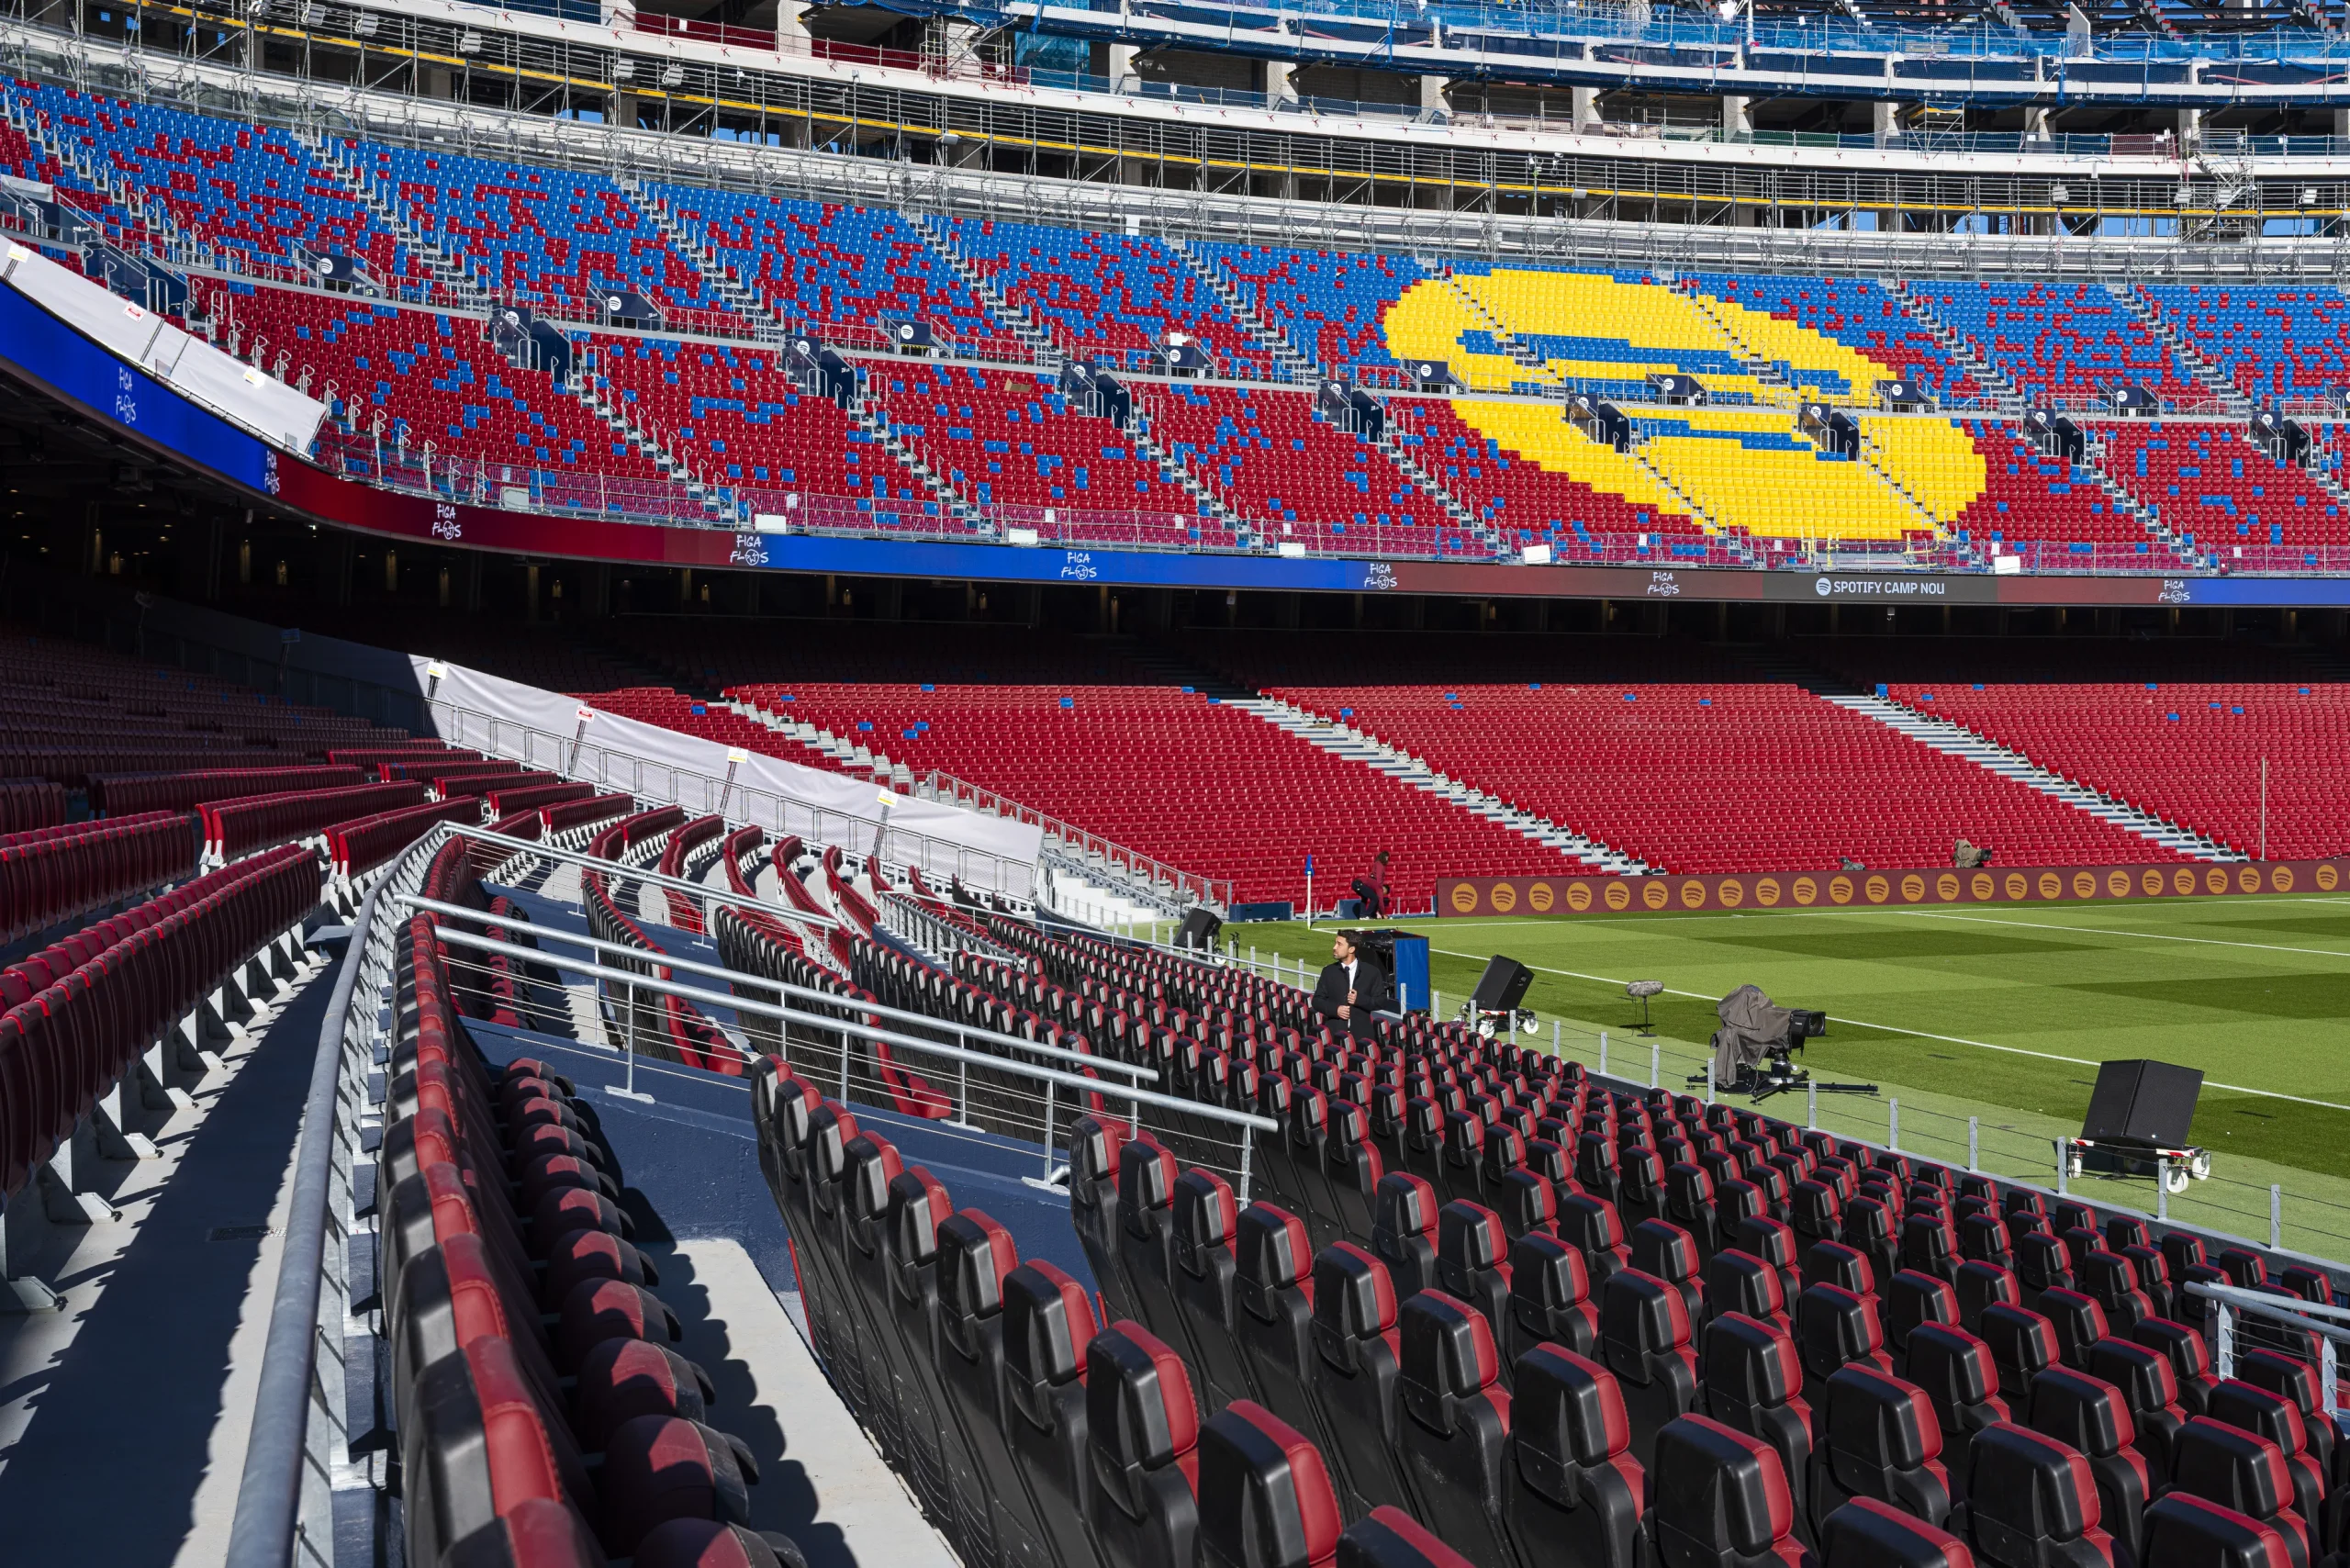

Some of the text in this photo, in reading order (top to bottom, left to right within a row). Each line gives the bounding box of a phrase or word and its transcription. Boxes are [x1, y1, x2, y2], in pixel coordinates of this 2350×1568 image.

[437, 503, 456, 520] FIGA
[736, 534, 762, 548] FIGA
[1067, 551, 1091, 564] FIGA
[1370, 563, 1392, 575] FIGA
[1652, 571, 1673, 583] FIGA
[1833, 580, 1945, 595] SPOTIFY CAMP NOU
[2164, 579, 2185, 590] FIGA
